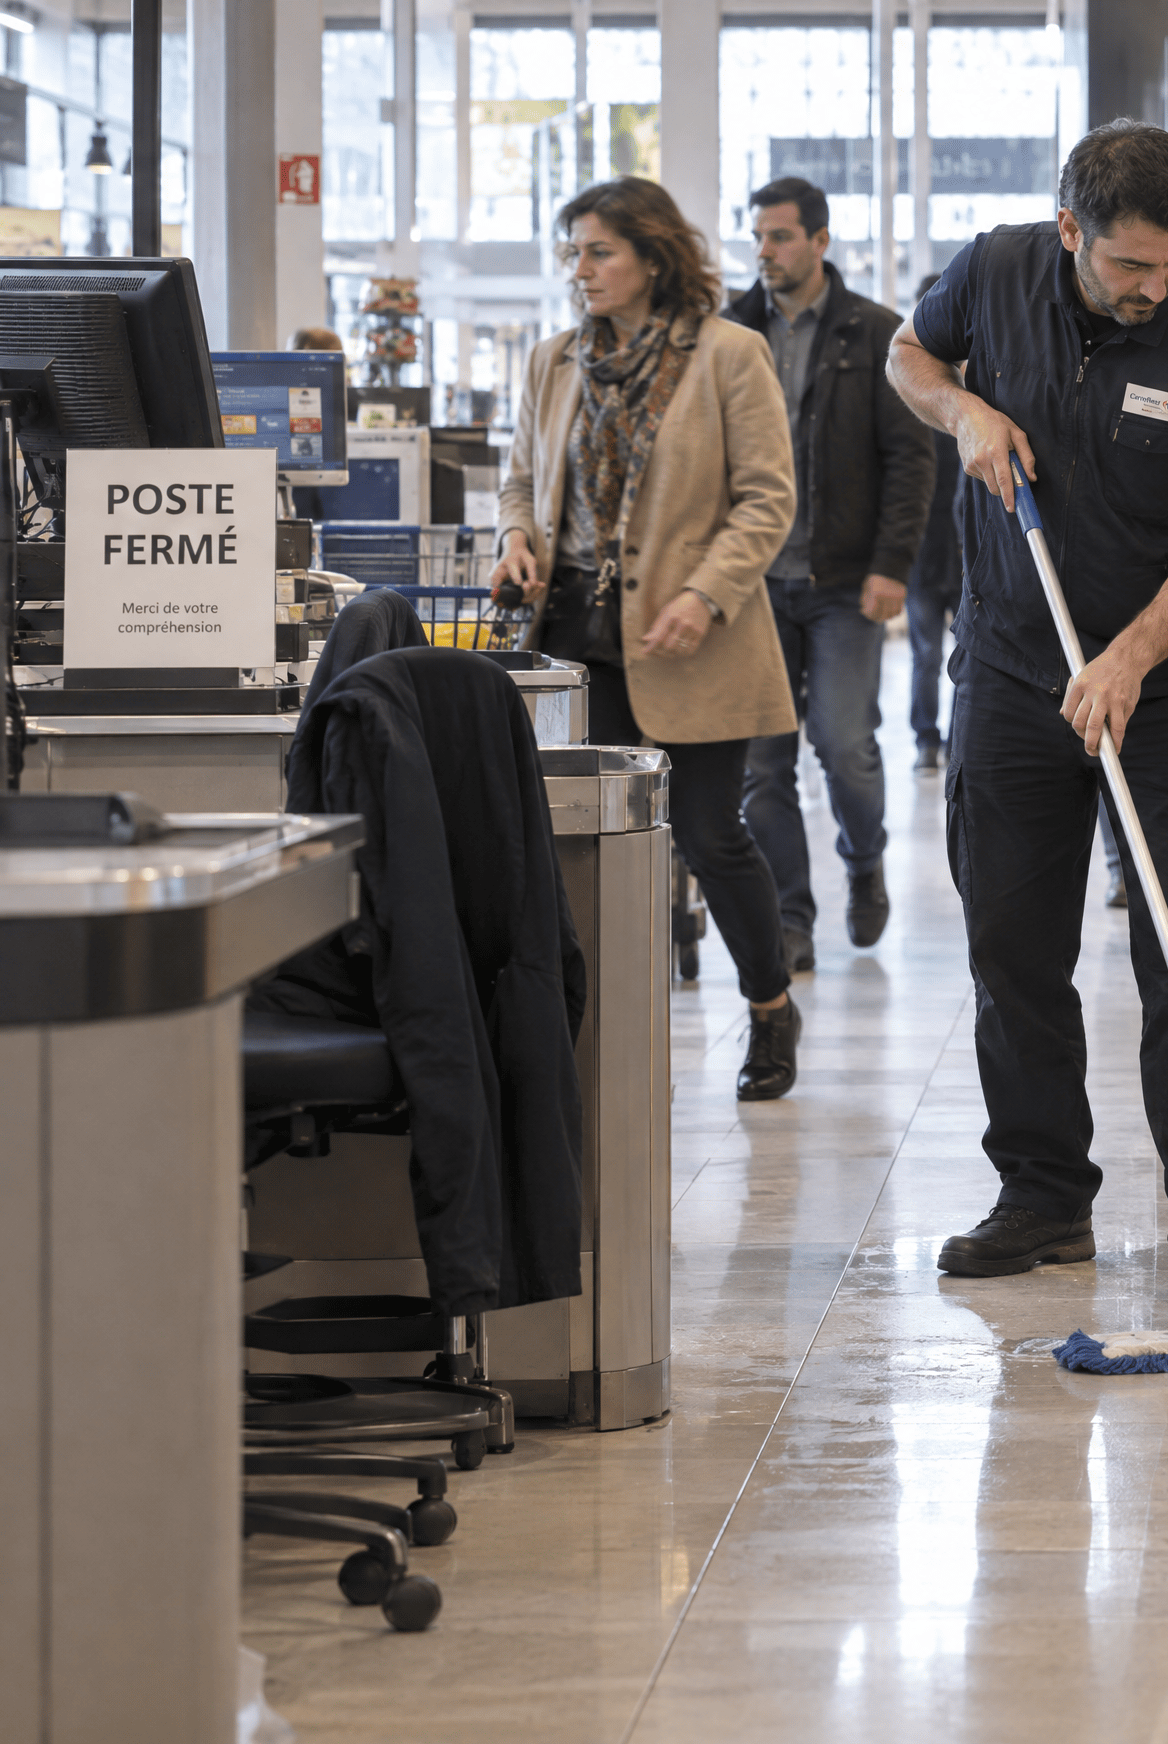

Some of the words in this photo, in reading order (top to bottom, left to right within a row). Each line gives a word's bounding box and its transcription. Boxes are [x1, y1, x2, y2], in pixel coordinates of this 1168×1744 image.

[106, 483, 234, 517] POSTE
[104, 525, 238, 565] FERMÉ
[122, 602, 159, 615] Merci
[163, 602, 180, 615] de
[184, 603, 219, 615] votre
[117, 620, 222, 636] compréhension
